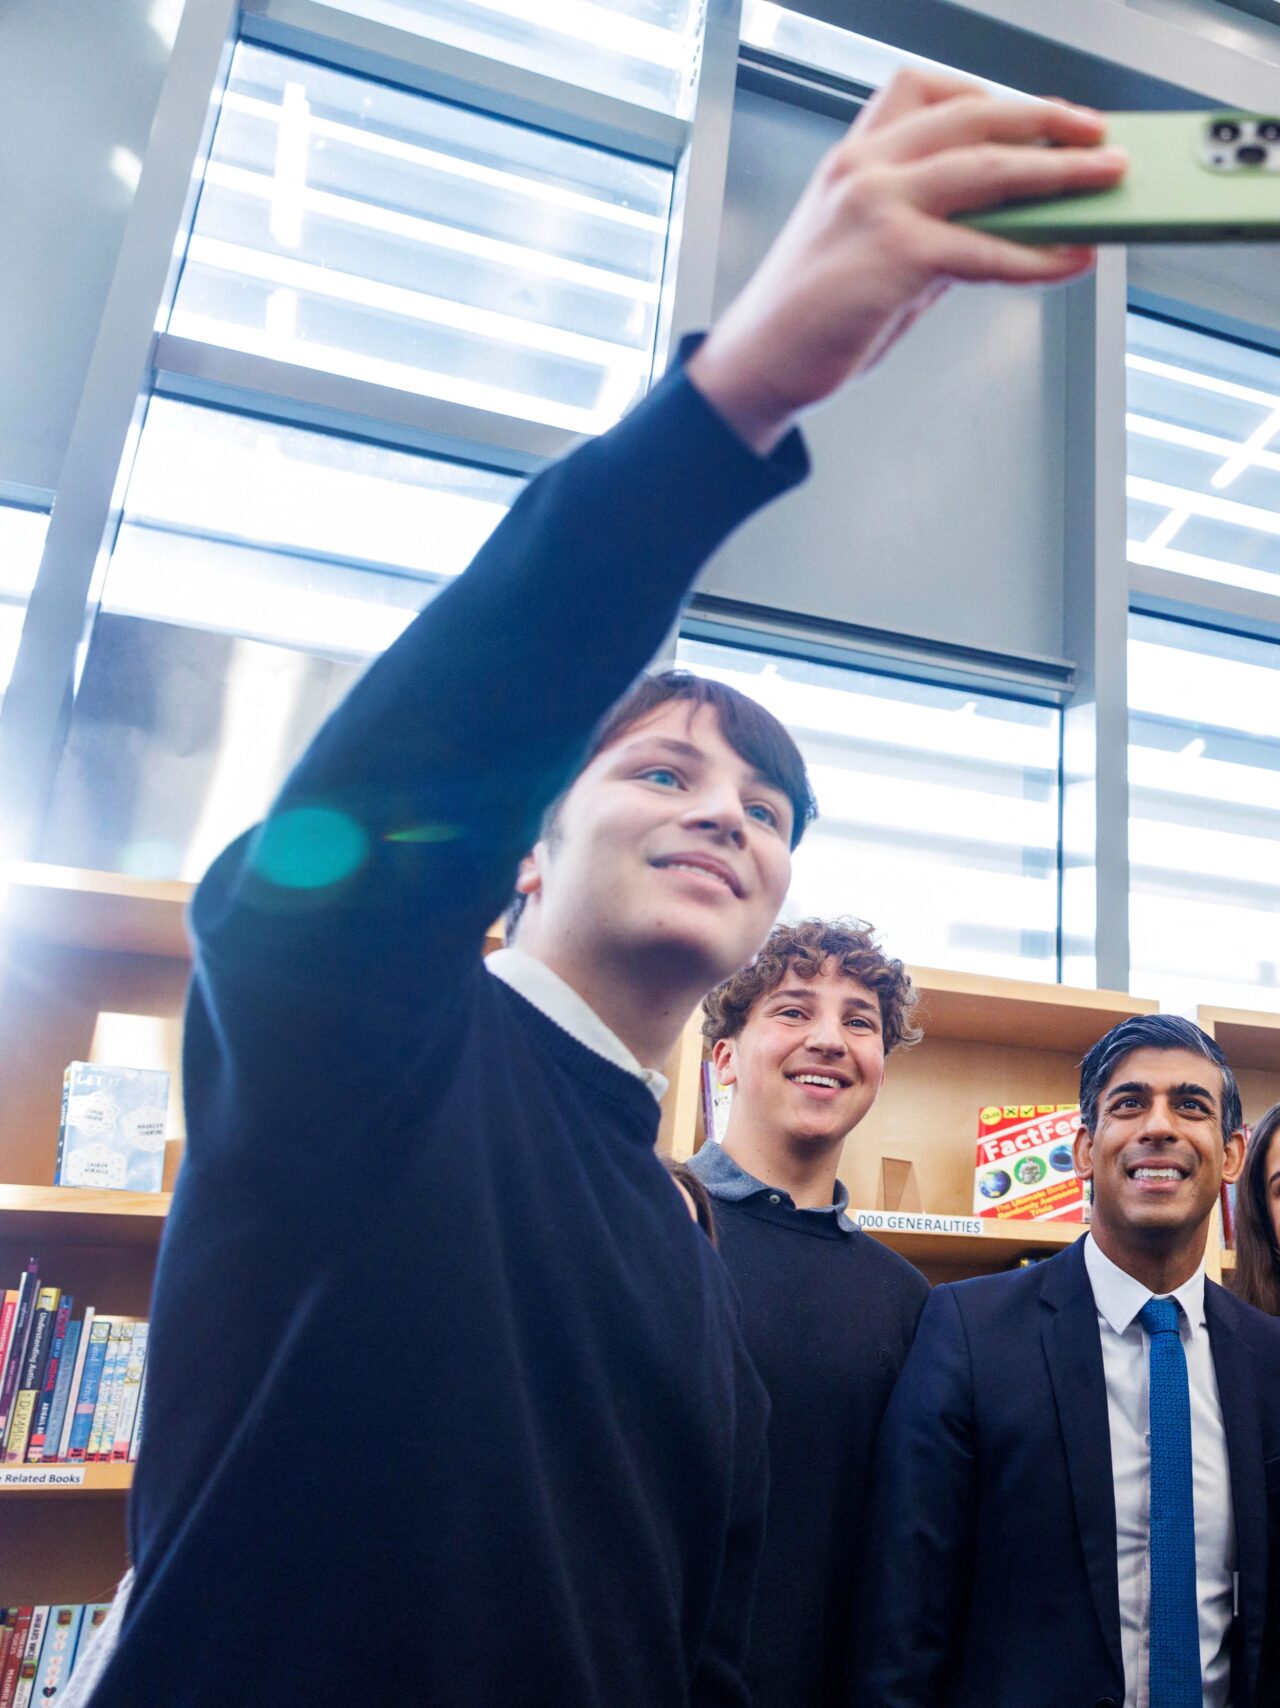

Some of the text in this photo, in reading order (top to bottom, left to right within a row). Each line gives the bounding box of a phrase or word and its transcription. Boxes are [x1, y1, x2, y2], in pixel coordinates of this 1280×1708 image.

[983, 1115, 1082, 1162] FactFee
[1040, 1186, 1080, 1206] Awesome
[858, 1214, 981, 1234] 000 GENERALITIES
[29, 1311, 47, 1363] Understanding
[25, 1363, 37, 1389] Autism
[5, 1473, 81, 1483] Related Books
